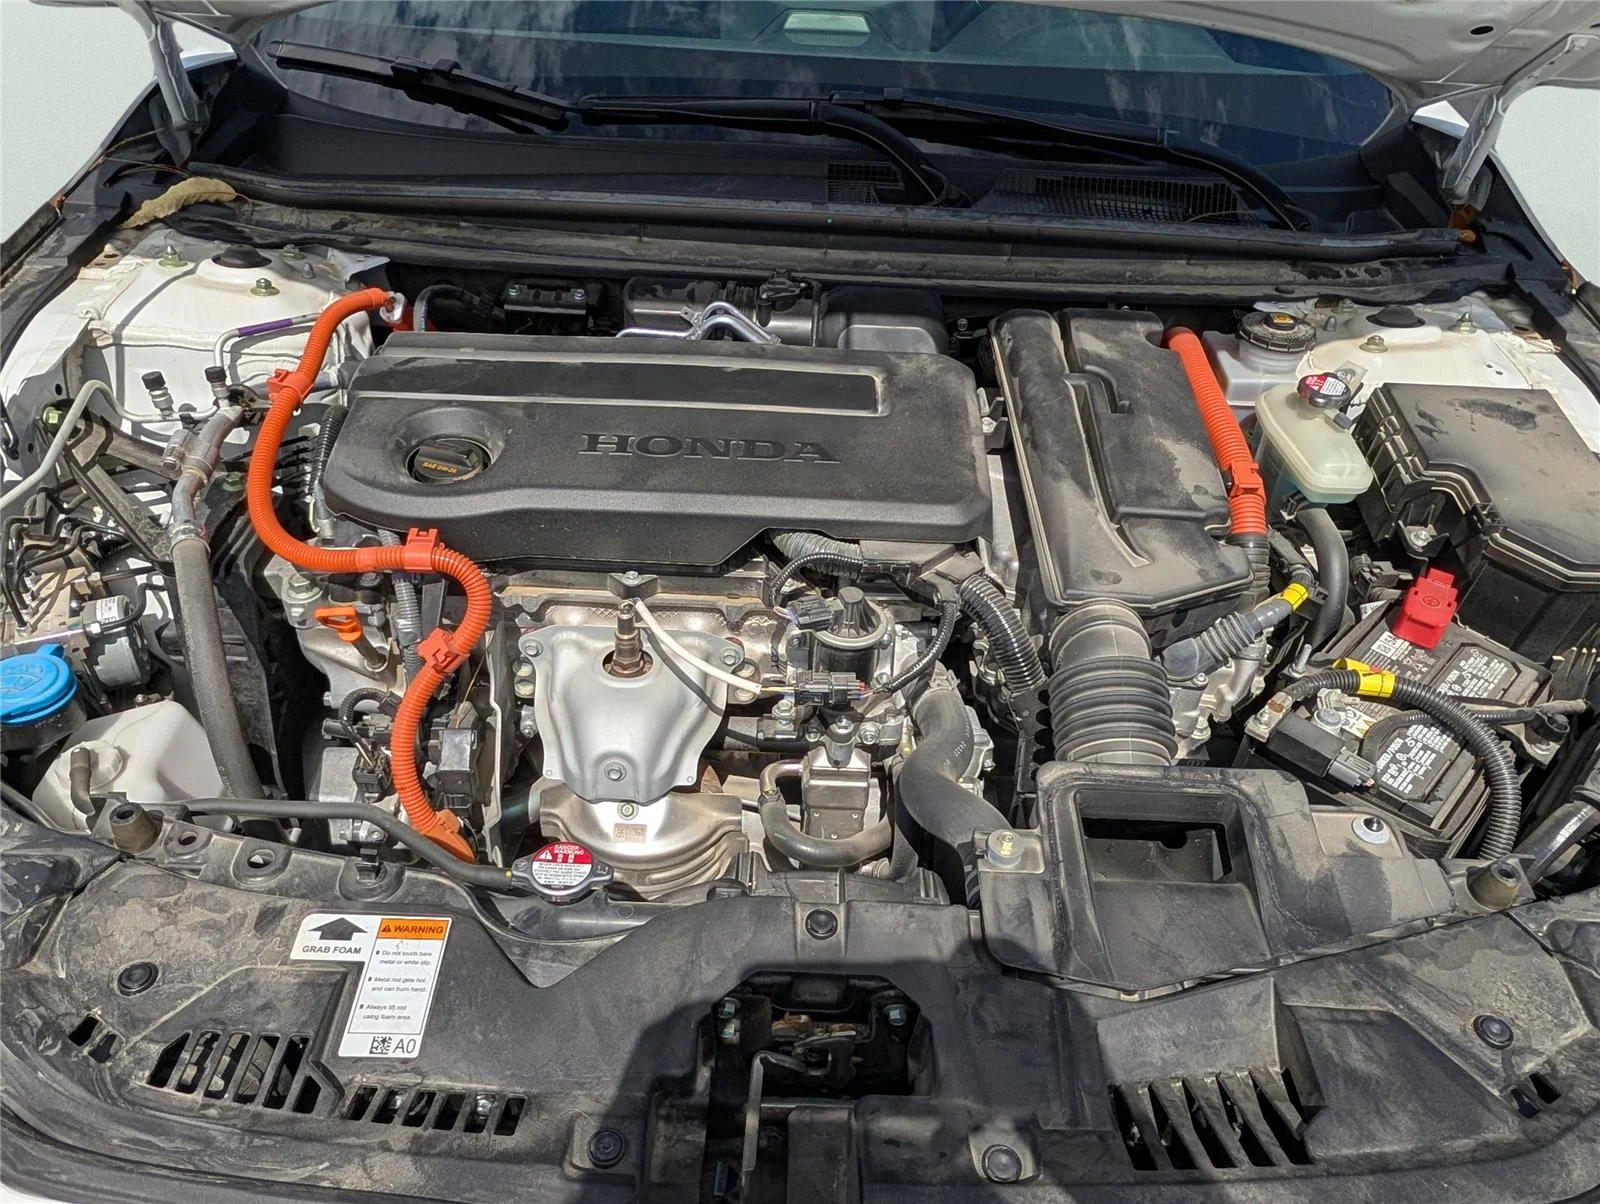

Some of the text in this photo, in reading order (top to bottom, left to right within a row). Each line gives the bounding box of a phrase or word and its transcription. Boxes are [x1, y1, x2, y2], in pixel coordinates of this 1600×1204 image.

[578, 433, 841, 464] HONDA
[393, 925, 444, 934] WARNING
[302, 945, 362, 955] GRAB FOAM
[393, 1038, 417, 1054] A0
